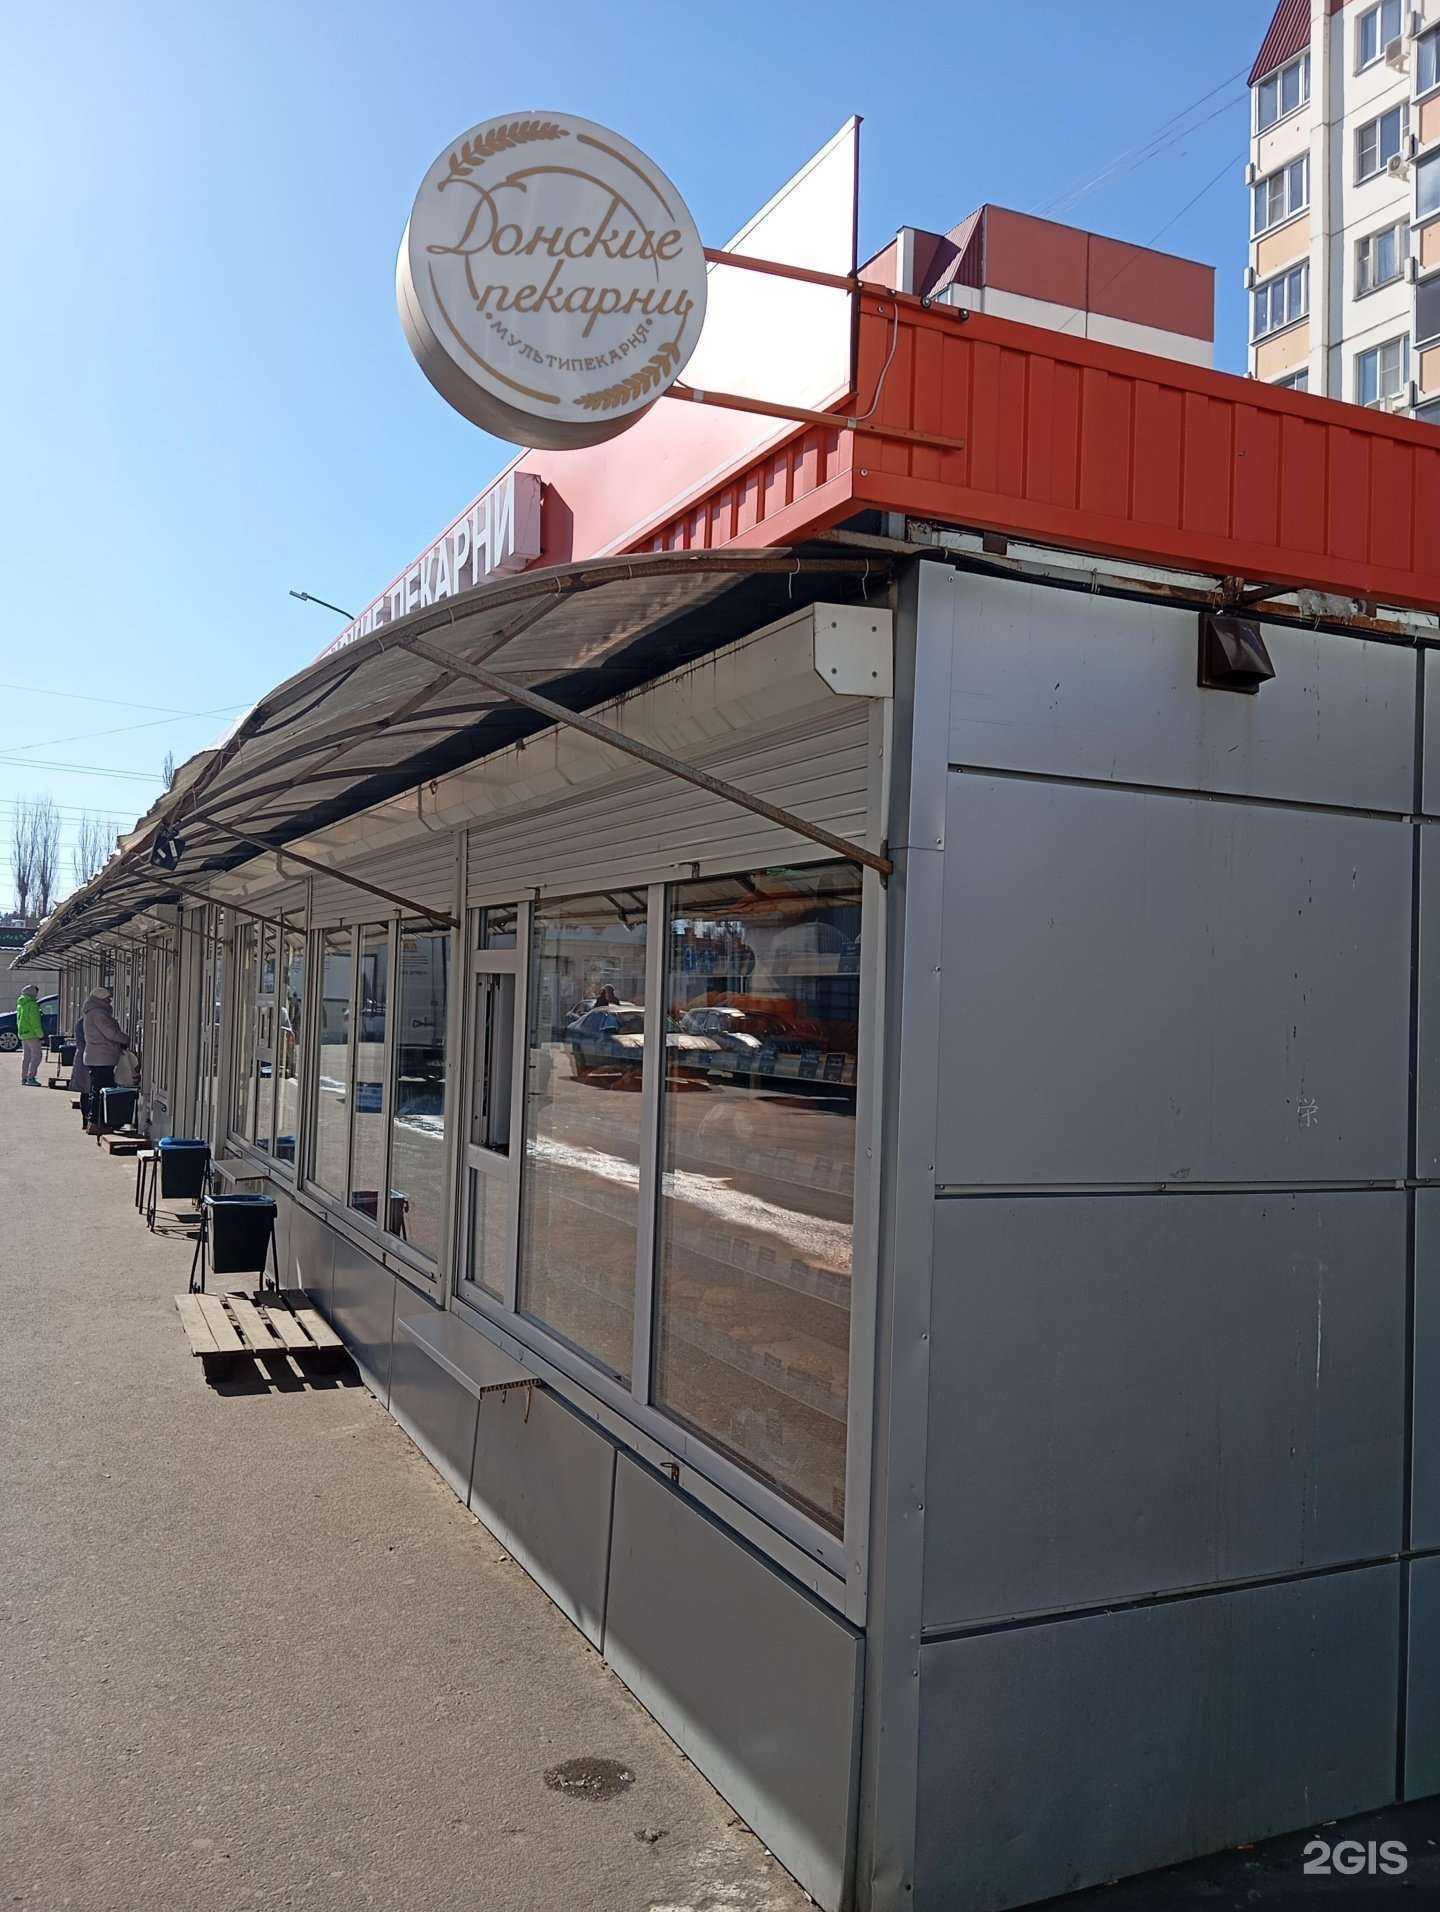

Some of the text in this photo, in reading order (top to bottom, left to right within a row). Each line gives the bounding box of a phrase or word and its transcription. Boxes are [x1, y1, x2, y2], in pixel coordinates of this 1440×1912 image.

[426, 178, 684, 261] Донские
[475, 258, 693, 338] пекарни
[489, 319, 650, 372] МУЛЬТИПЕКАРНЯ
[390, 471, 517, 622] ПЕКАРНИ
